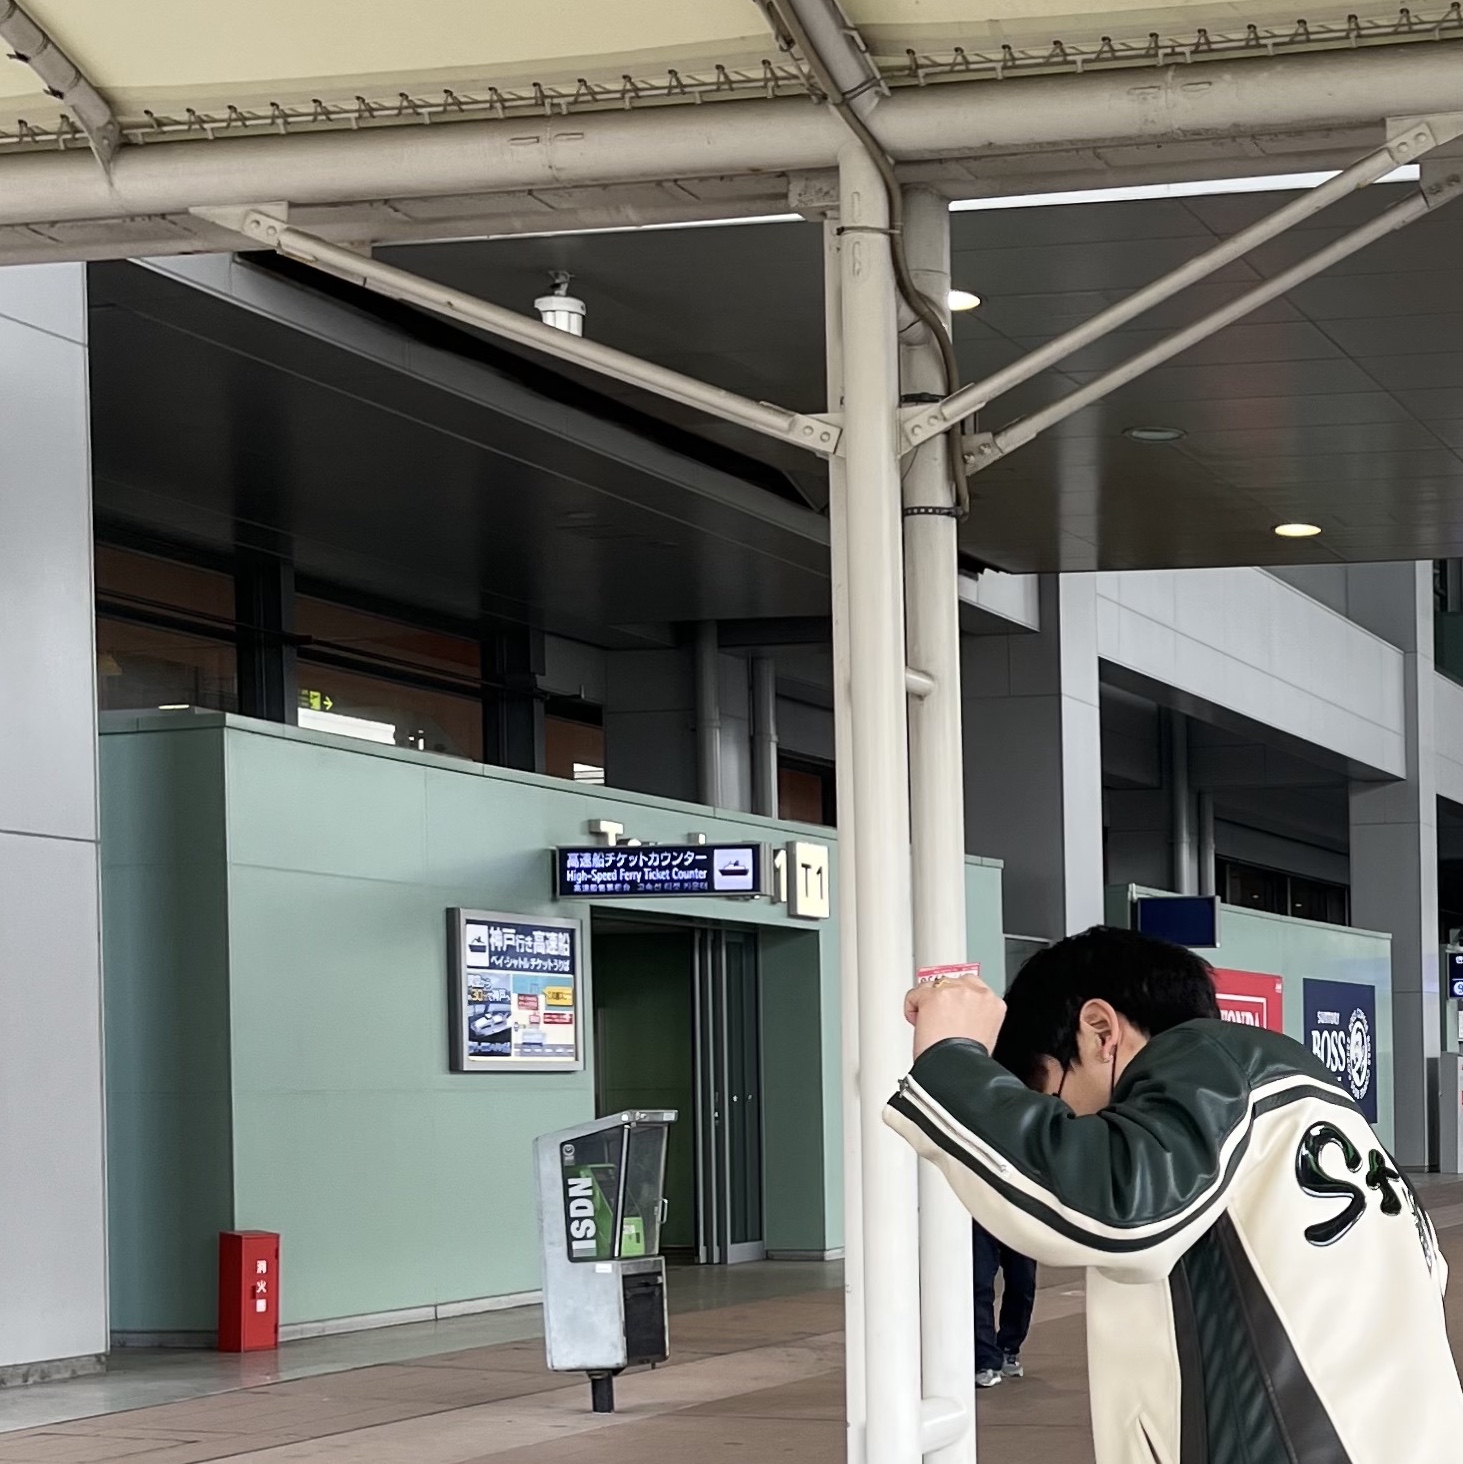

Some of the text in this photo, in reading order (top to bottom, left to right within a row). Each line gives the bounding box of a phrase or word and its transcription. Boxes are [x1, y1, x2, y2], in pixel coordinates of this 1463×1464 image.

[566, 850, 708, 869] 高速船チケットカウンター
[566, 868, 708, 884] High-Speed Ferry Ticket Counter
[800, 863, 824, 900] T1
[489, 926, 571, 957] 神戸行き高速船
[1311, 1030, 1346, 1072] BOSS
[567, 1177, 597, 1258] ISDN
